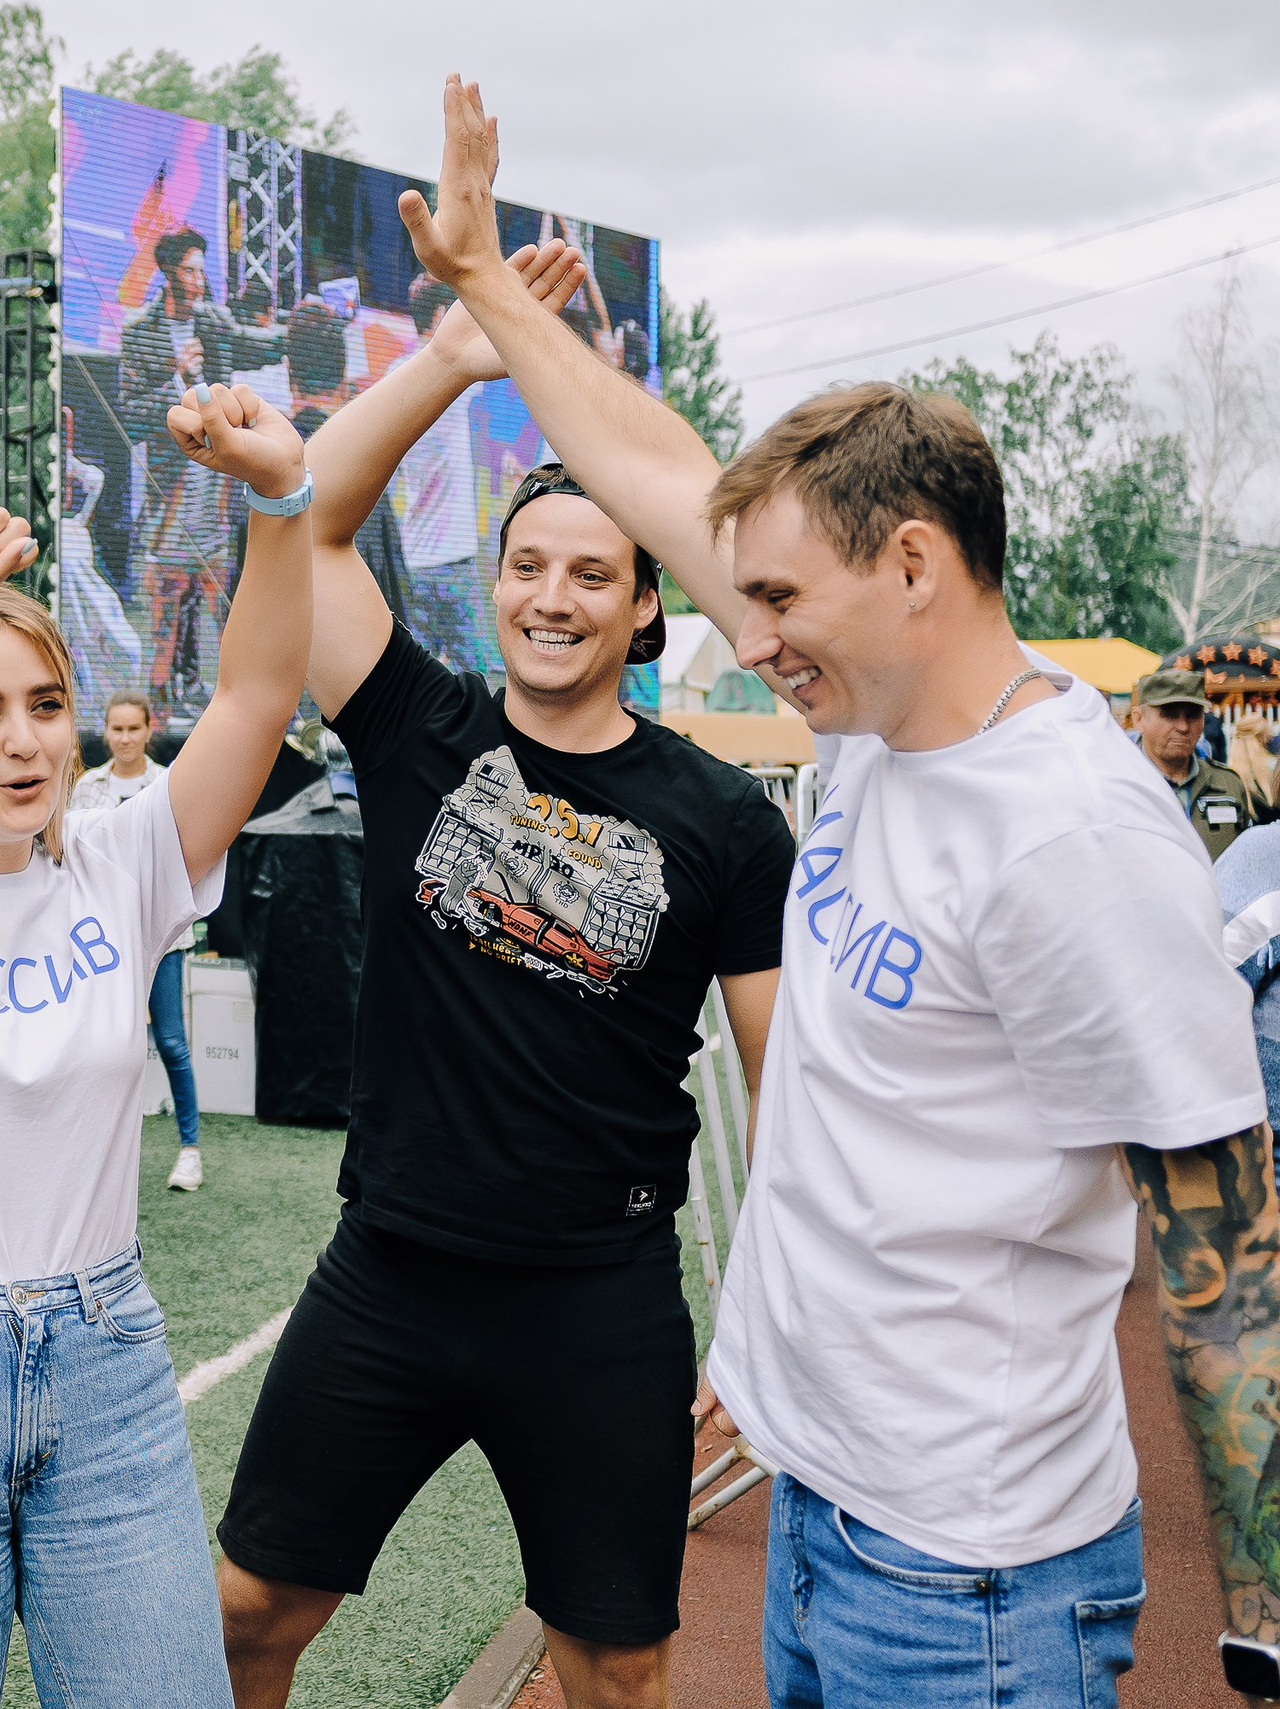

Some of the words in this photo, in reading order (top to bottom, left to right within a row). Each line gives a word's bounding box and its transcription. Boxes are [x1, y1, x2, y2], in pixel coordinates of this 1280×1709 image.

[510, 815, 547, 832] TUNING
[567, 849, 602, 870] FOUND
[205, 1046, 239, 1060] 952794
